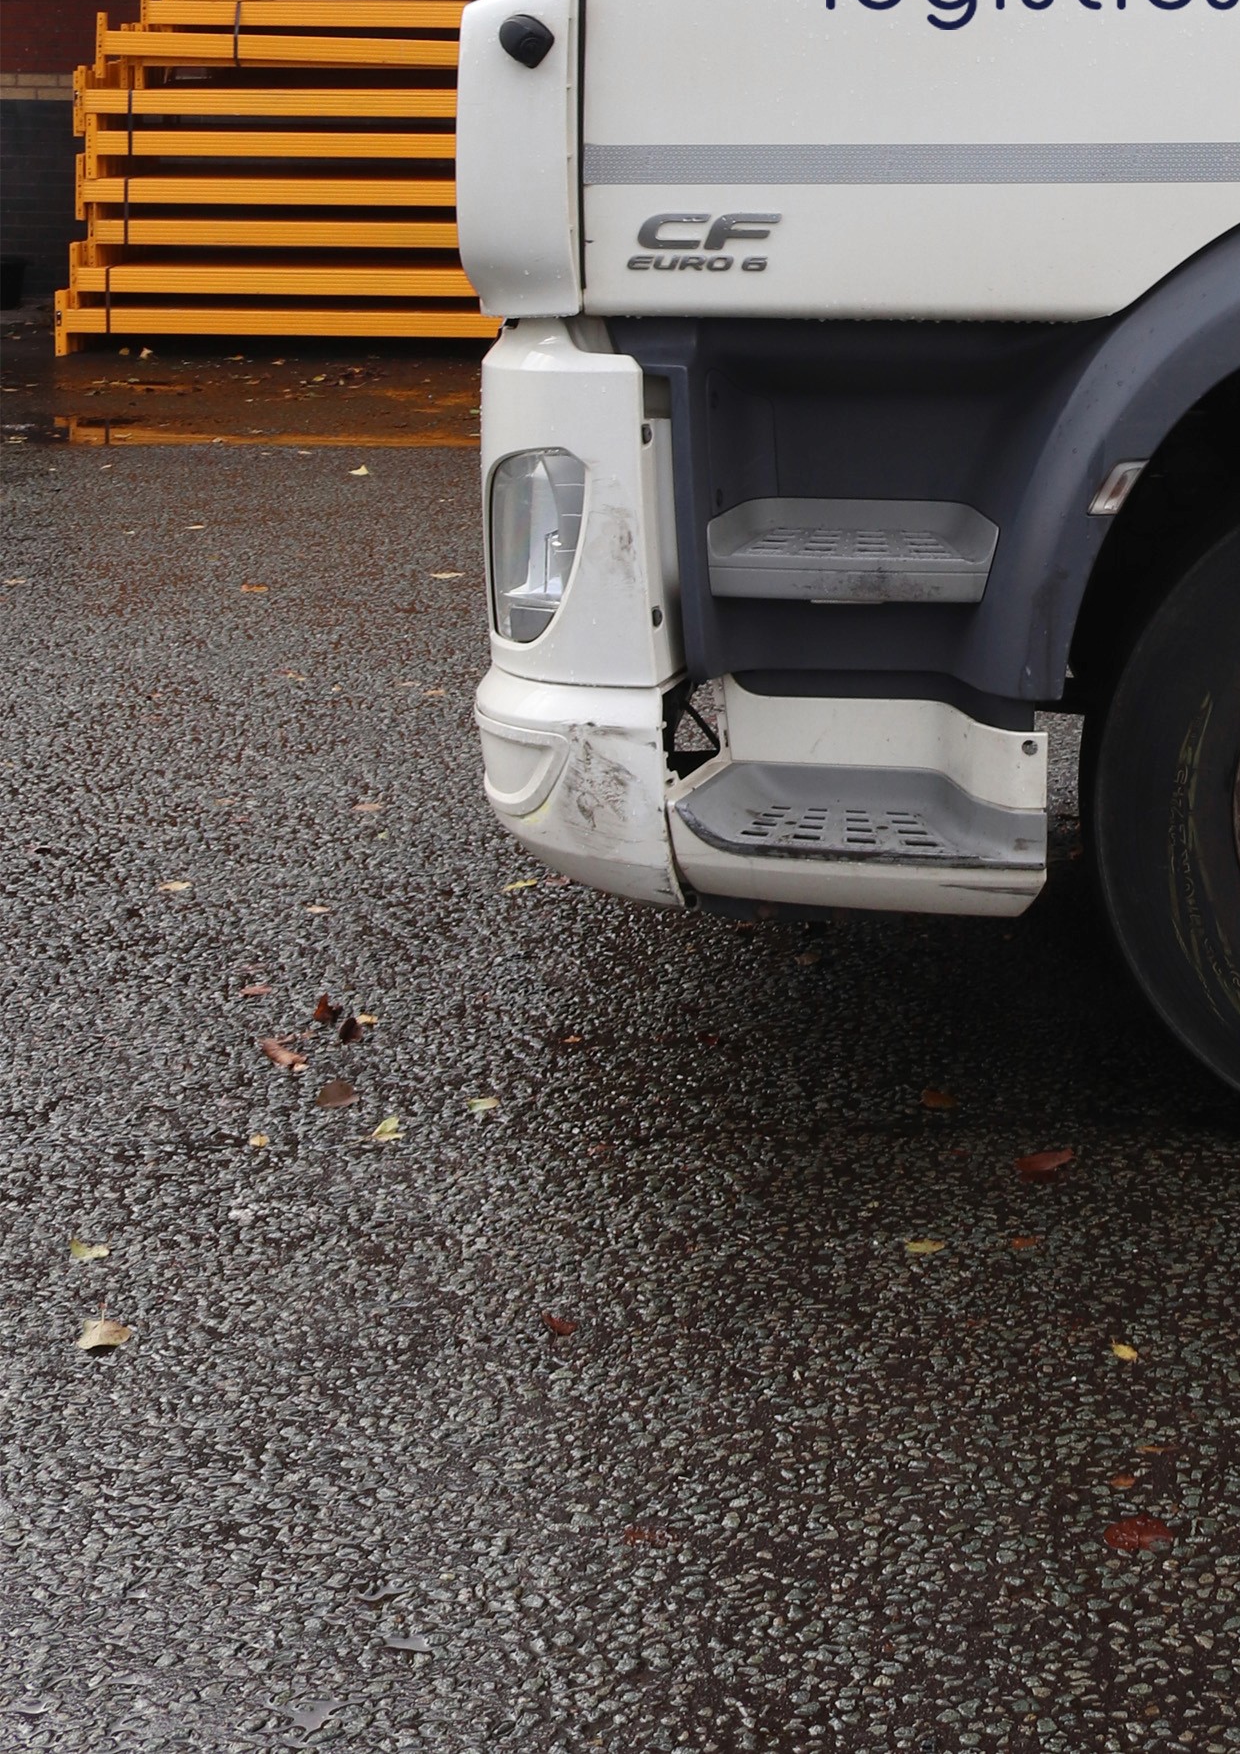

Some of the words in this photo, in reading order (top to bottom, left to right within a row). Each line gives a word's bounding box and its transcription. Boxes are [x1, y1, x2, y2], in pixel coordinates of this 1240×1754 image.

[637, 212, 782, 250] CF
[626, 254, 734, 272] EURO
[741, 256, 769, 272] 6
